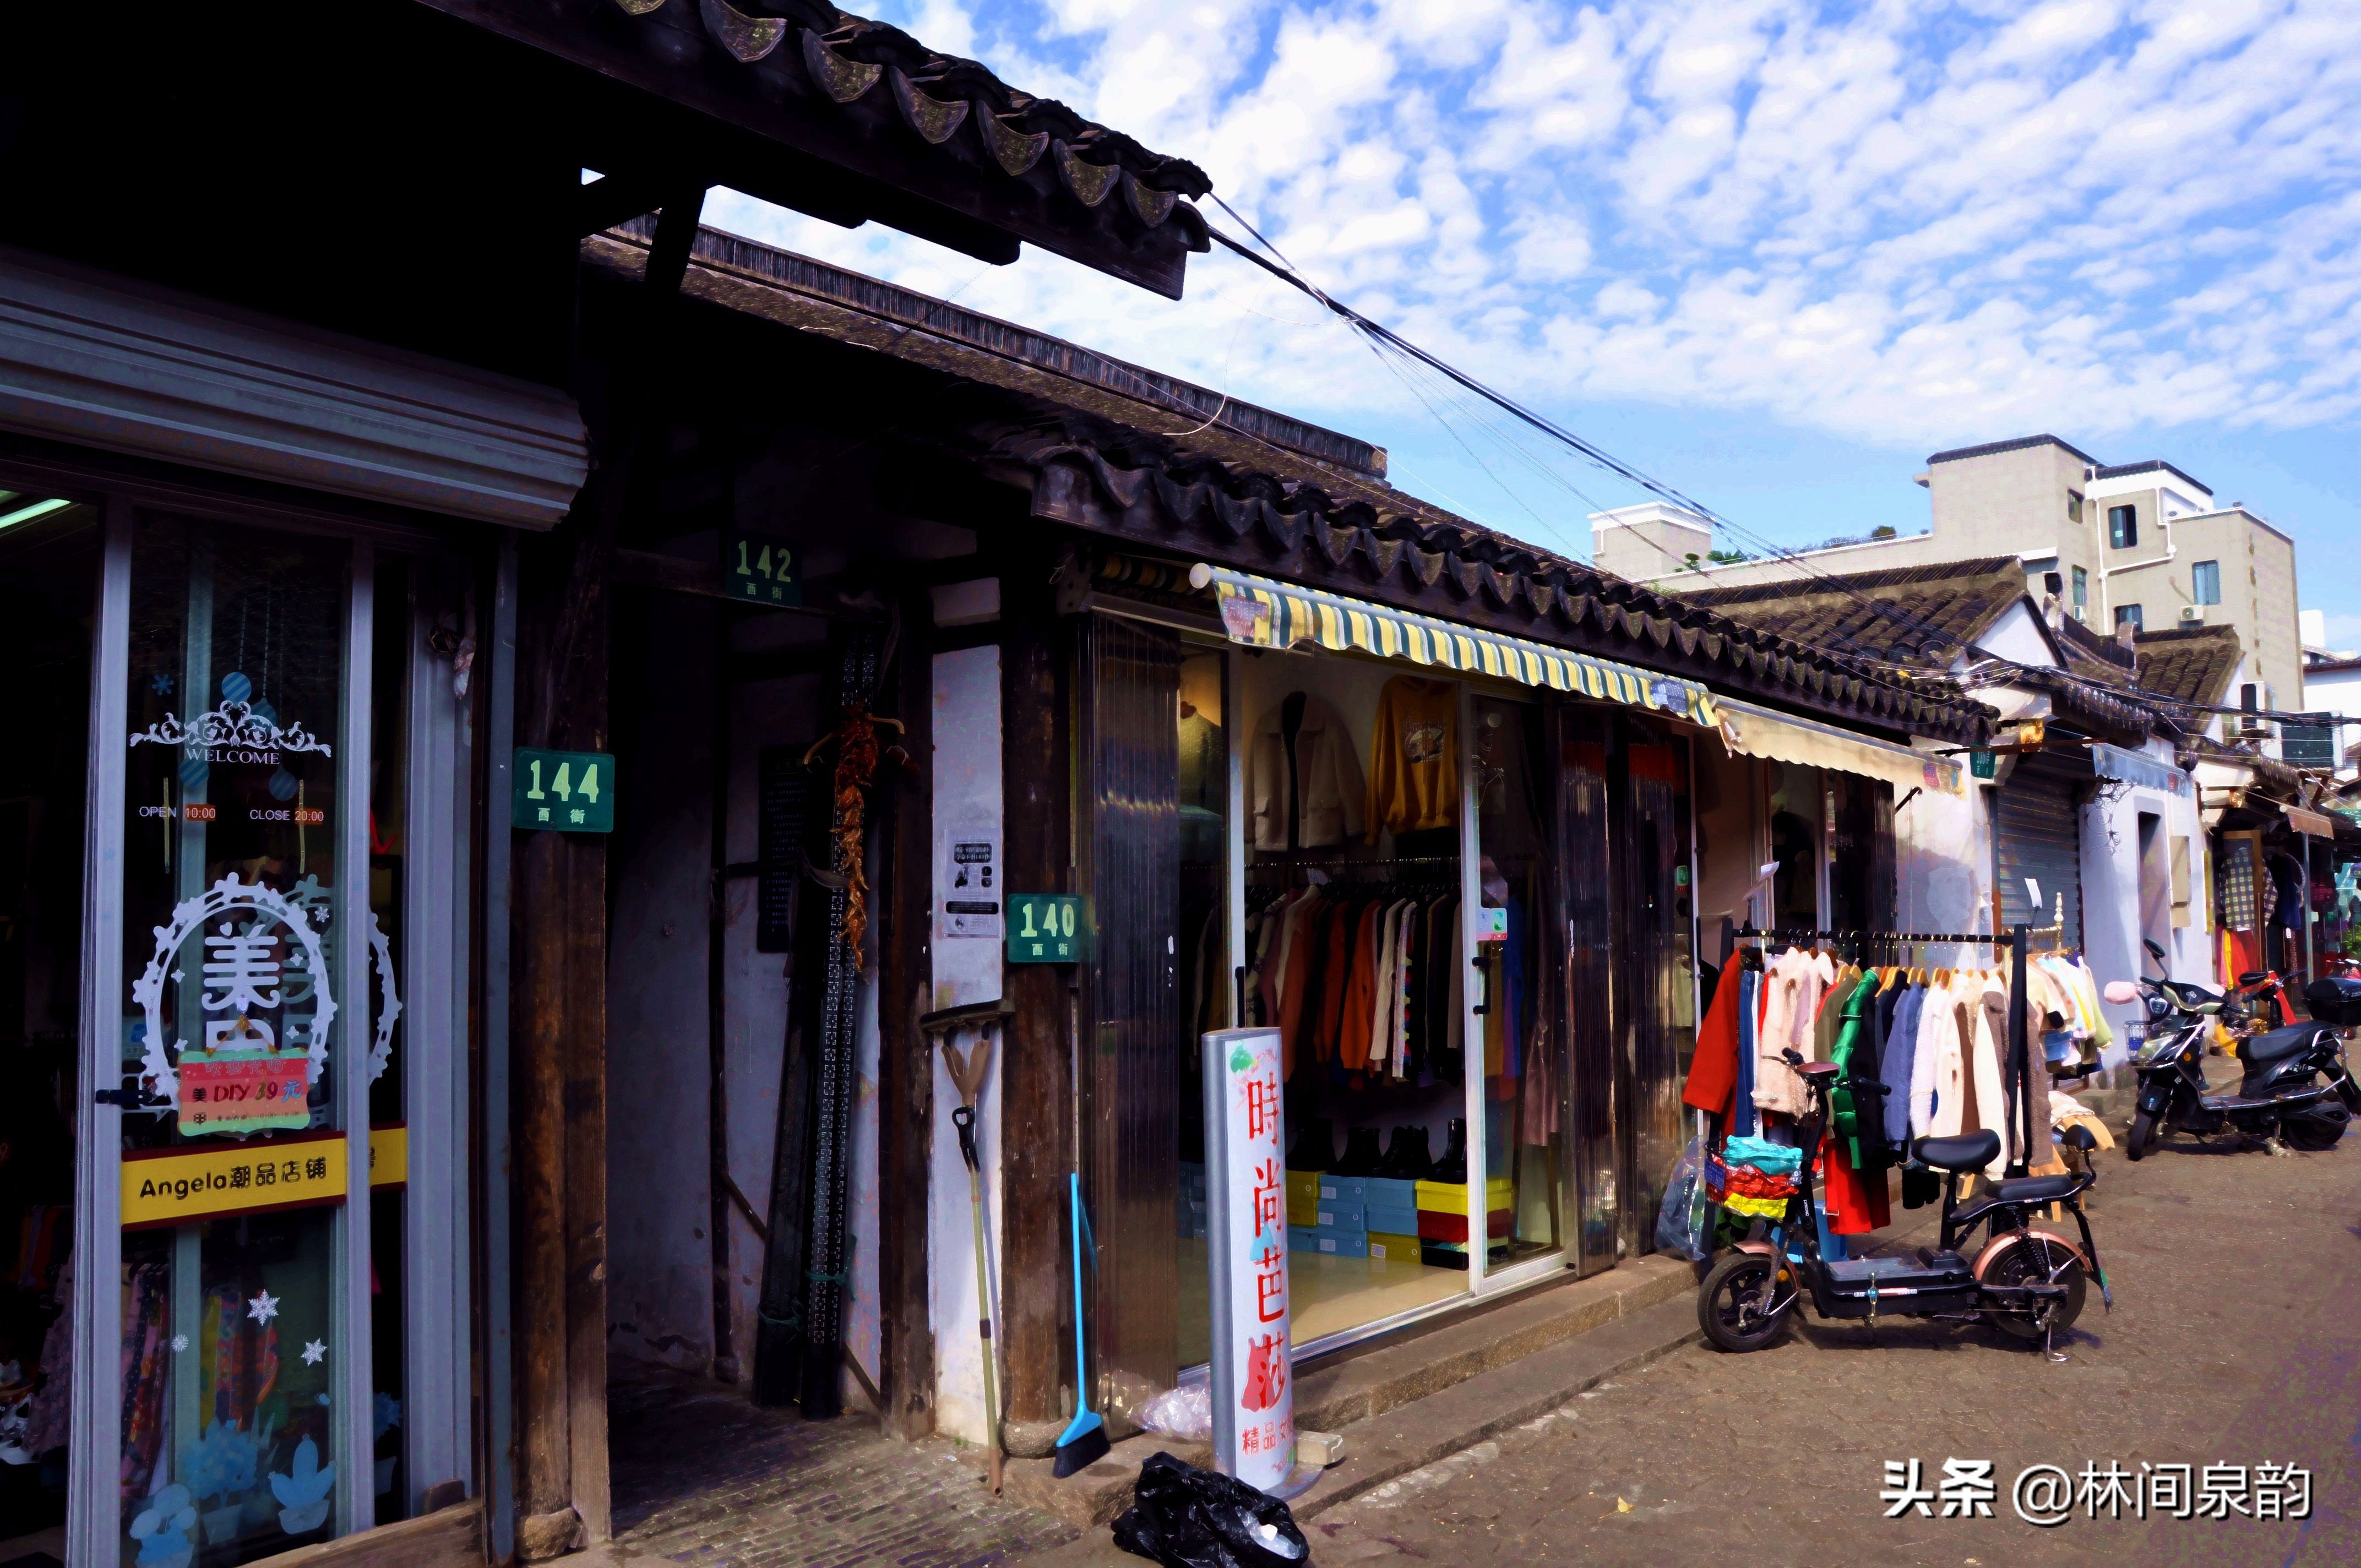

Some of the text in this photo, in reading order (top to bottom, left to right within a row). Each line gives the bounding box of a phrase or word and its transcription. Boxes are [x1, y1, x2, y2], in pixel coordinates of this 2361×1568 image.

[737, 540, 792, 583] 142
[747, 582, 782, 601] 西街
[186, 748, 280, 765] WELCOME
[527, 760, 599, 803] 144
[139, 806, 216, 819] OPEN 10:00
[249, 809, 324, 822] CLOSE 20:00
[537, 807, 585, 824] 西街
[1020, 903, 1075, 937] 140
[1031, 943, 1069, 956] 西街
[205, 1058, 283, 1076] 欢迎光临
[213, 1083, 251, 1102] DIY
